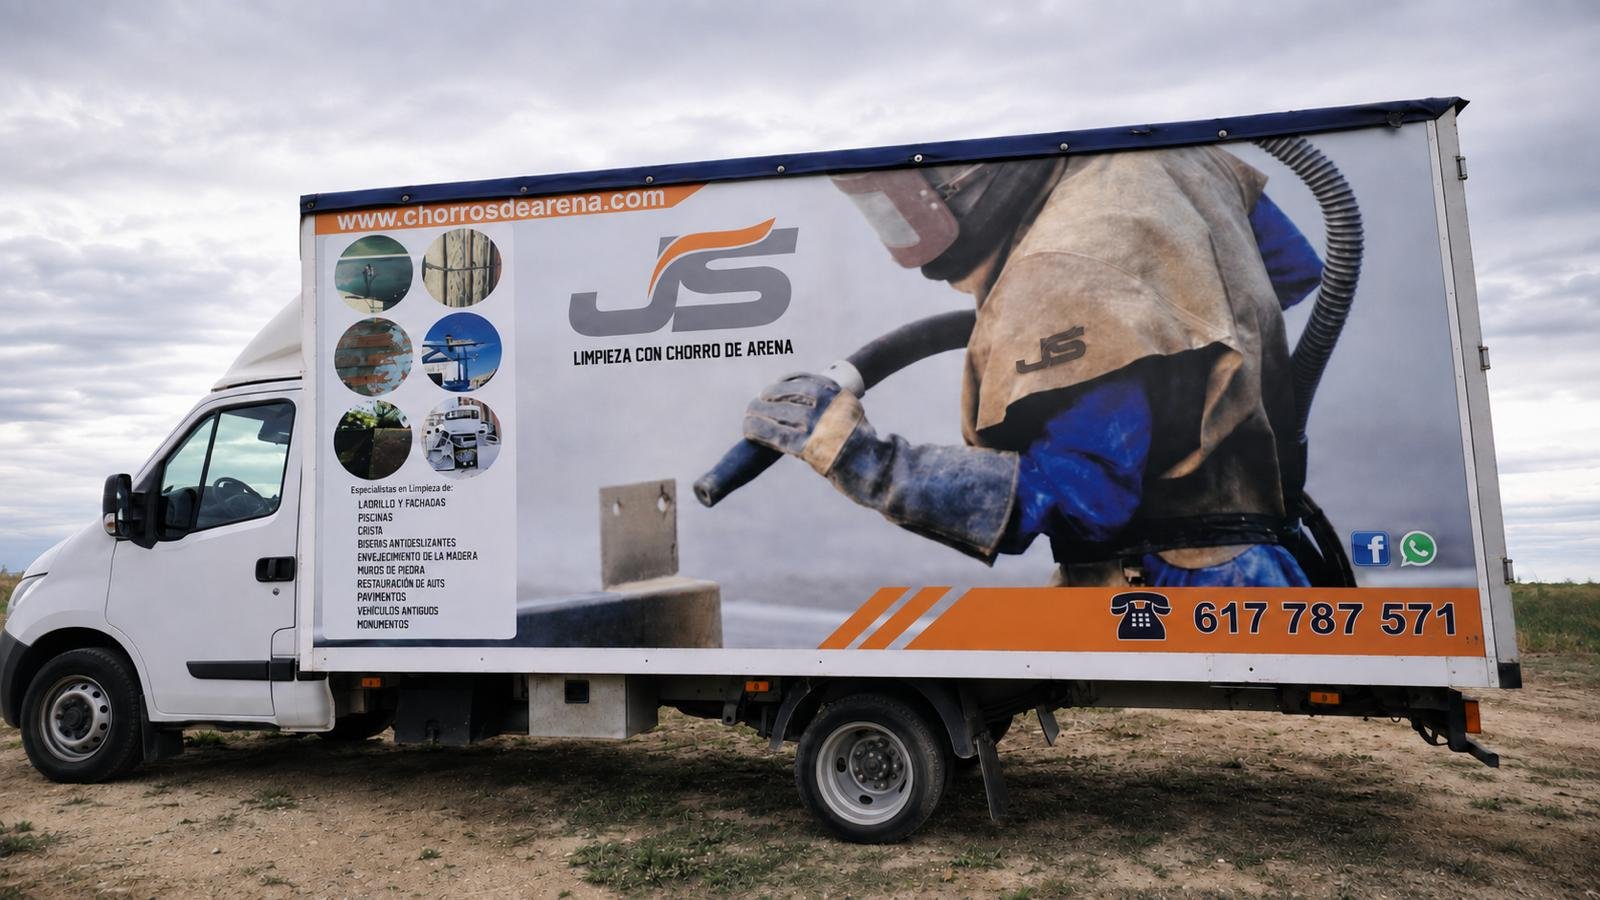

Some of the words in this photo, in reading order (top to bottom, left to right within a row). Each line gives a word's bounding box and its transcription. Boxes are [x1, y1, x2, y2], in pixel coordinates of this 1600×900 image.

[337, 189, 664, 231] www.chorrosdearena.com
[568, 217, 799, 337] JS
[573, 345, 631, 366] LIMPIEZA
[635, 344, 661, 363] CON
[666, 342, 720, 361] CHORRO
[724, 341, 743, 358] DE
[747, 339, 794, 357] ARENA
[1016, 326, 1086, 374] JS
[351, 485, 396, 496] Especialistas
[409, 485, 440, 494] Limpieza
[442, 484, 453, 492] de:
[358, 499, 395, 509] LADRILLO
[398, 499, 403, 508] Y
[405, 498, 446, 508] FACHADAS
[358, 513, 393, 522] PISCINAS
[358, 526, 383, 536] CRISTA
[389, 538, 456, 548] ANTIDESLIZANTES
[358, 552, 420, 562] ENVEJECIMIENTO
[423, 552, 432, 560] DE
[435, 552, 444, 560] LA
[446, 551, 478, 560] MADERA
[358, 566, 384, 575] MUROS
[387, 565, 395, 574] DE
[398, 565, 425, 574] PIEDRA
[358, 578, 413, 588] RESTAURACIÓN
[416, 579, 425, 588] DE
[357, 592, 406, 602] PAVIMENTOS
[402, 606, 438, 615] ANTIGUOS
[1193, 601, 1269, 635] 617
[1282, 602, 1364, 636] 787
[1380, 602, 1456, 637] 571
[357, 620, 409, 629] MONUMENTOS
